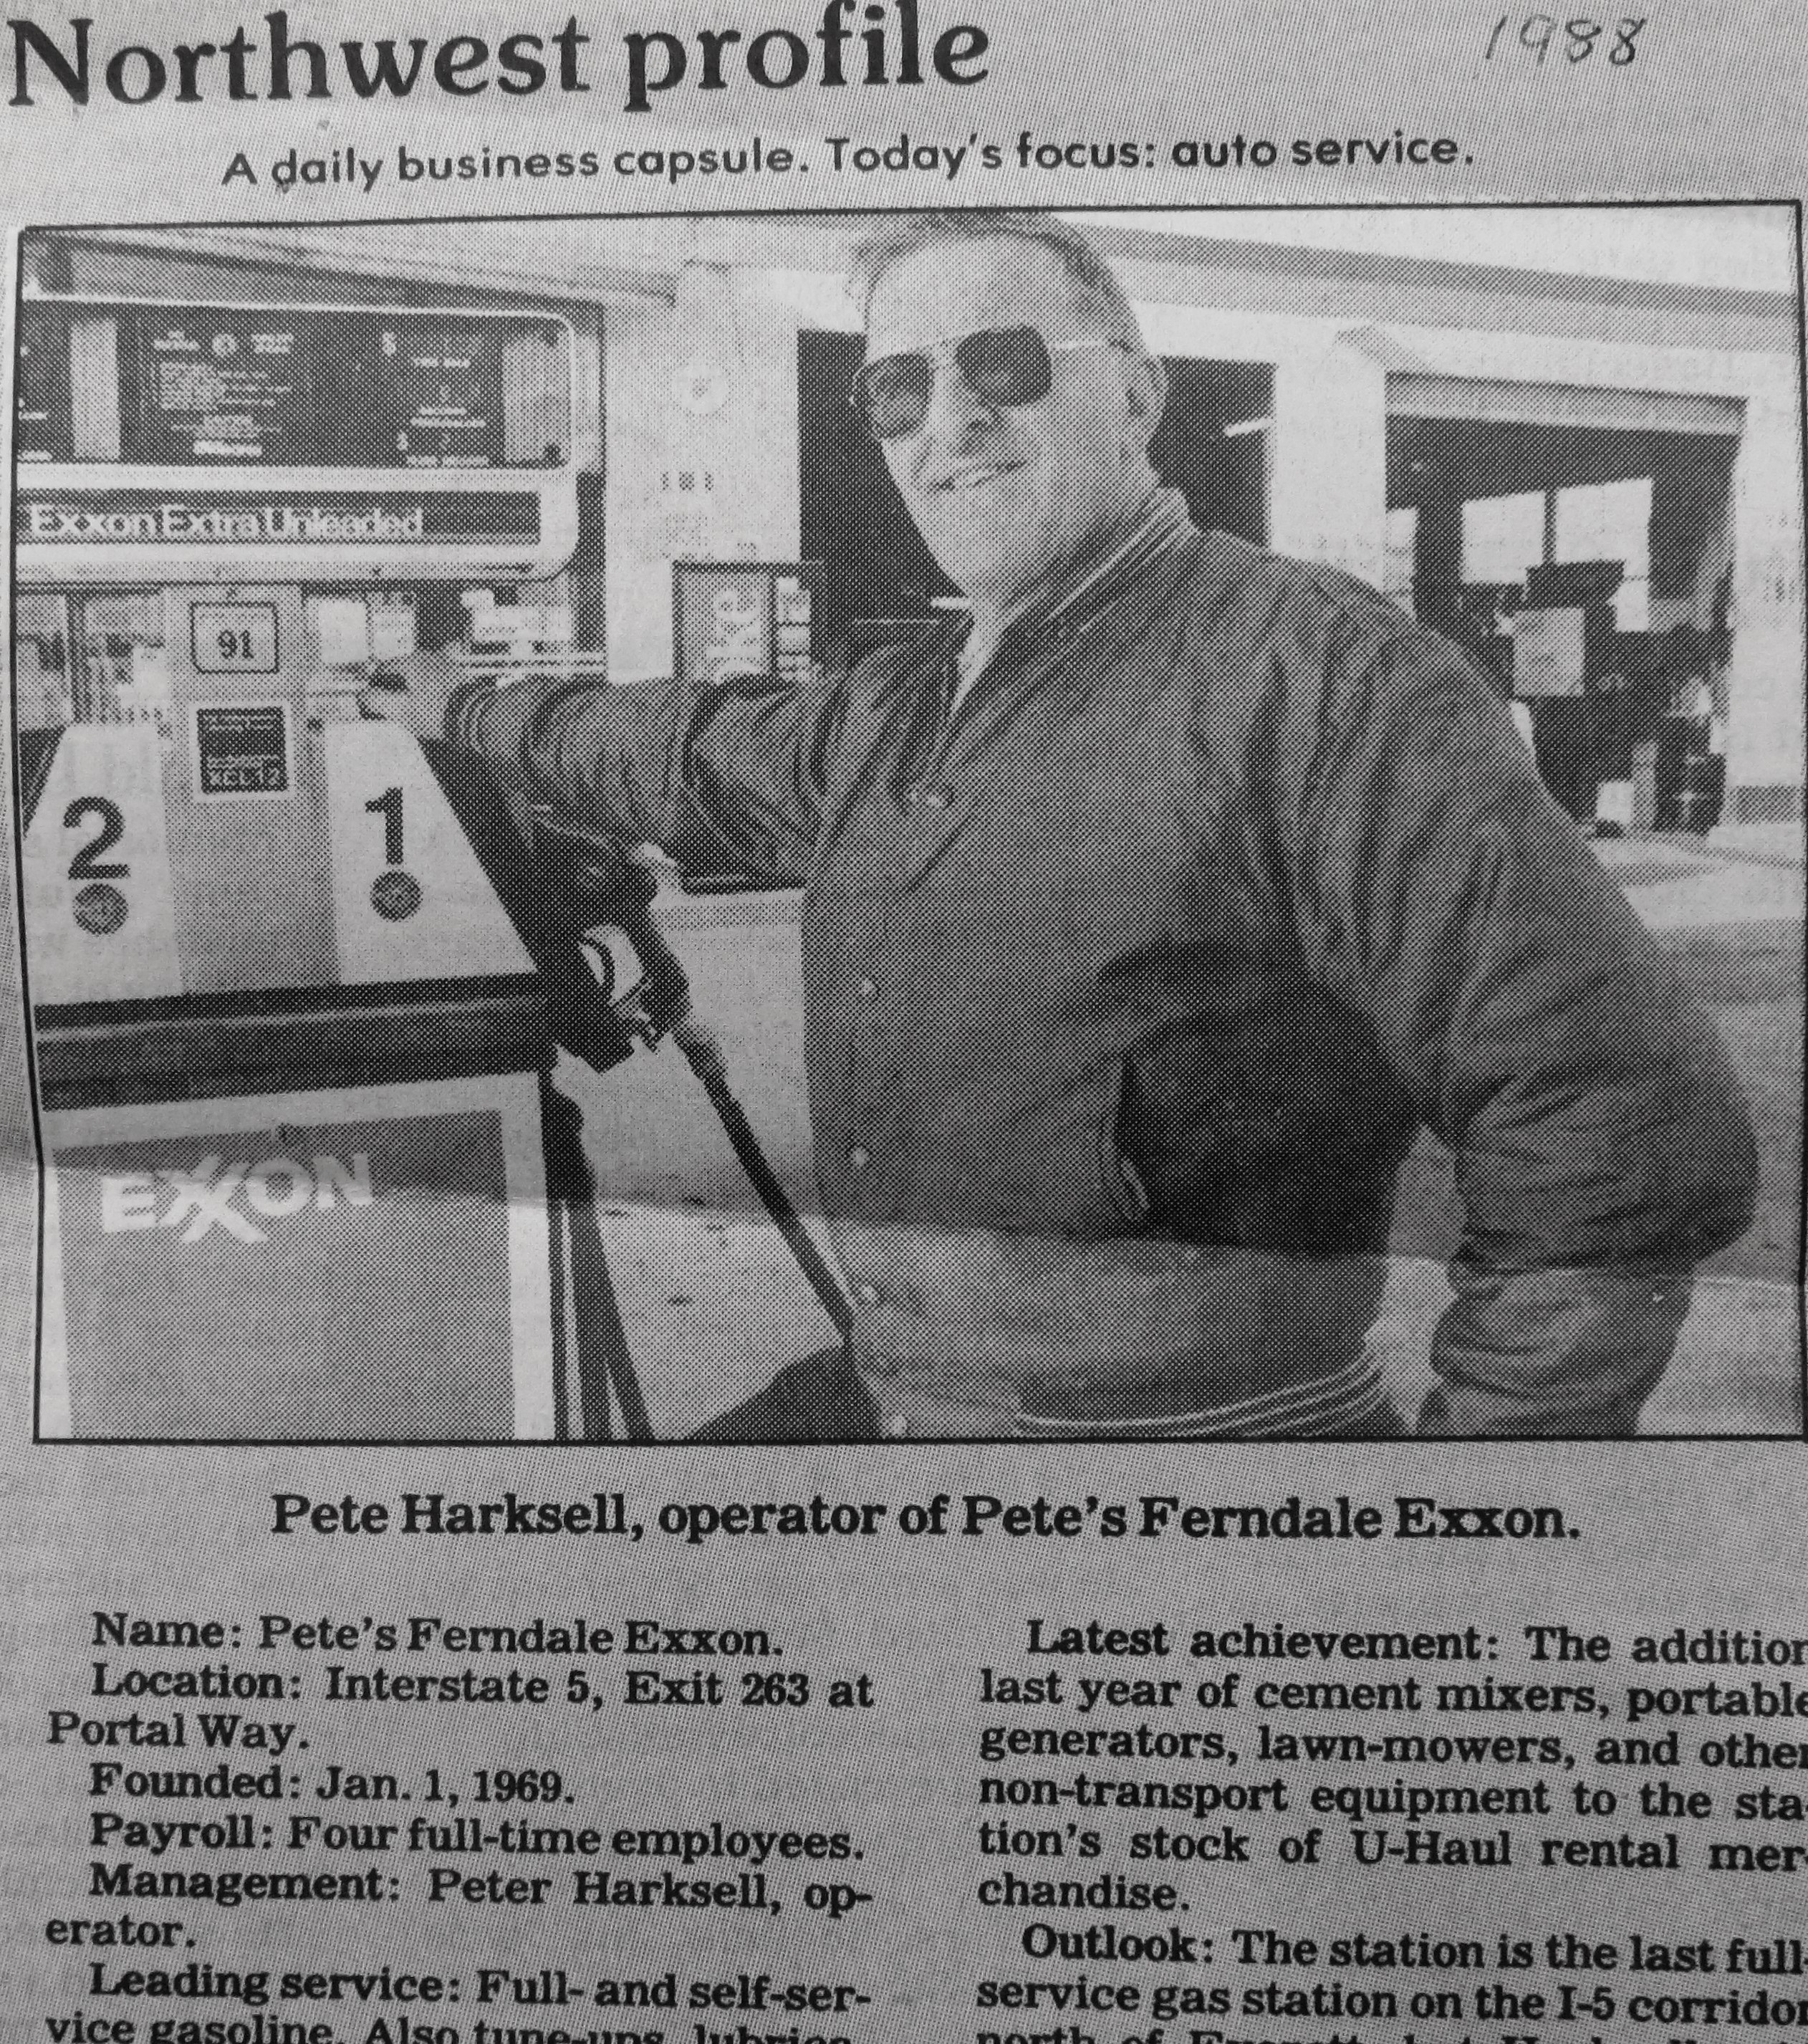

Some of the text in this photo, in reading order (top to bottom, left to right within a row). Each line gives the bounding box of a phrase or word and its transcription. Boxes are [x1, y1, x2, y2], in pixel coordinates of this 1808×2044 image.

[7, 0, 989, 112] Northwest profile
[1486, 14, 1647, 66] 1988
[223, 130, 1472, 191] A daily business capsule. Today's focus: auto service.
[30, 504, 423, 539] Exxon Extra Unleaded
[218, 630, 254, 659] 91
[63, 797, 130, 880] 2
[365, 788, 404, 864] 1
[102, 1153, 372, 1243] EXXON
[271, 1492, 1580, 1545] Pete Harksell, operator of Pete's Ferndale Exxon.
[92, 1612, 782, 1656] Name: Pete's Ferndale Exxon.
[1027, 1619, 1170, 1656] Latest
[1191, 1623, 1497, 1661] achievement:
[1524, 1626, 1610, 1663] The
[92, 1663, 874, 1711] Location: Interstate 5, Exit 263 at
[981, 1668, 1063, 1704] last
[1077, 1679, 1181, 1713] year
[1197, 1673, 1240, 1708] of
[1254, 1677, 1421, 1711] cement
[1437, 1676, 1610, 1719] mixers,
[48, 1711, 308, 1756] Portal Way.
[980, 1724, 1237, 1765] generators,
[1258, 1725, 1574, 1770] lawn-mowers,
[1595, 1731, 1679, 1766] and
[90, 1762, 574, 1808] Founded: Jan. 1, 1969.
[980, 1774, 1808, 1822] non-transport equipment to the sta
[91, 1812, 863, 1866] Payroll: Four full-time employees.
[979, 1820, 1808, 1872] tion's stock of U-Haul rental mer
[90, 1862, 872, 1919] Management: Peter Harksell, op-
[978, 1872, 1188, 1911] chandise.
[46, 1915, 194, 1947] erator.
[1022, 1923, 1212, 1963] Outlook:
[1232, 1929, 1317, 1966] The
[1329, 1933, 1484, 1969] station
[1498, 1934, 1534, 1969] is
[1546, 1934, 1617, 1970] the
[1630, 1935, 1716, 1973] last
[90, 1962, 870, 2012] Leading service: Full- and self-ser-
[977, 1976, 1139, 2010] service
[1153, 1987, 1230, 2020] gas
[1243, 1982, 1397, 2018] station
[1410, 1992, 1463, 2019] on
[1475, 1985, 1545, 2020] the
[1557, 1985, 1615, 2020] I-5
[46, 2011, 133, 2044] vice
[151, 2015, 343, 2044] gasoline
[366, 2017, 458, 2044] Also
